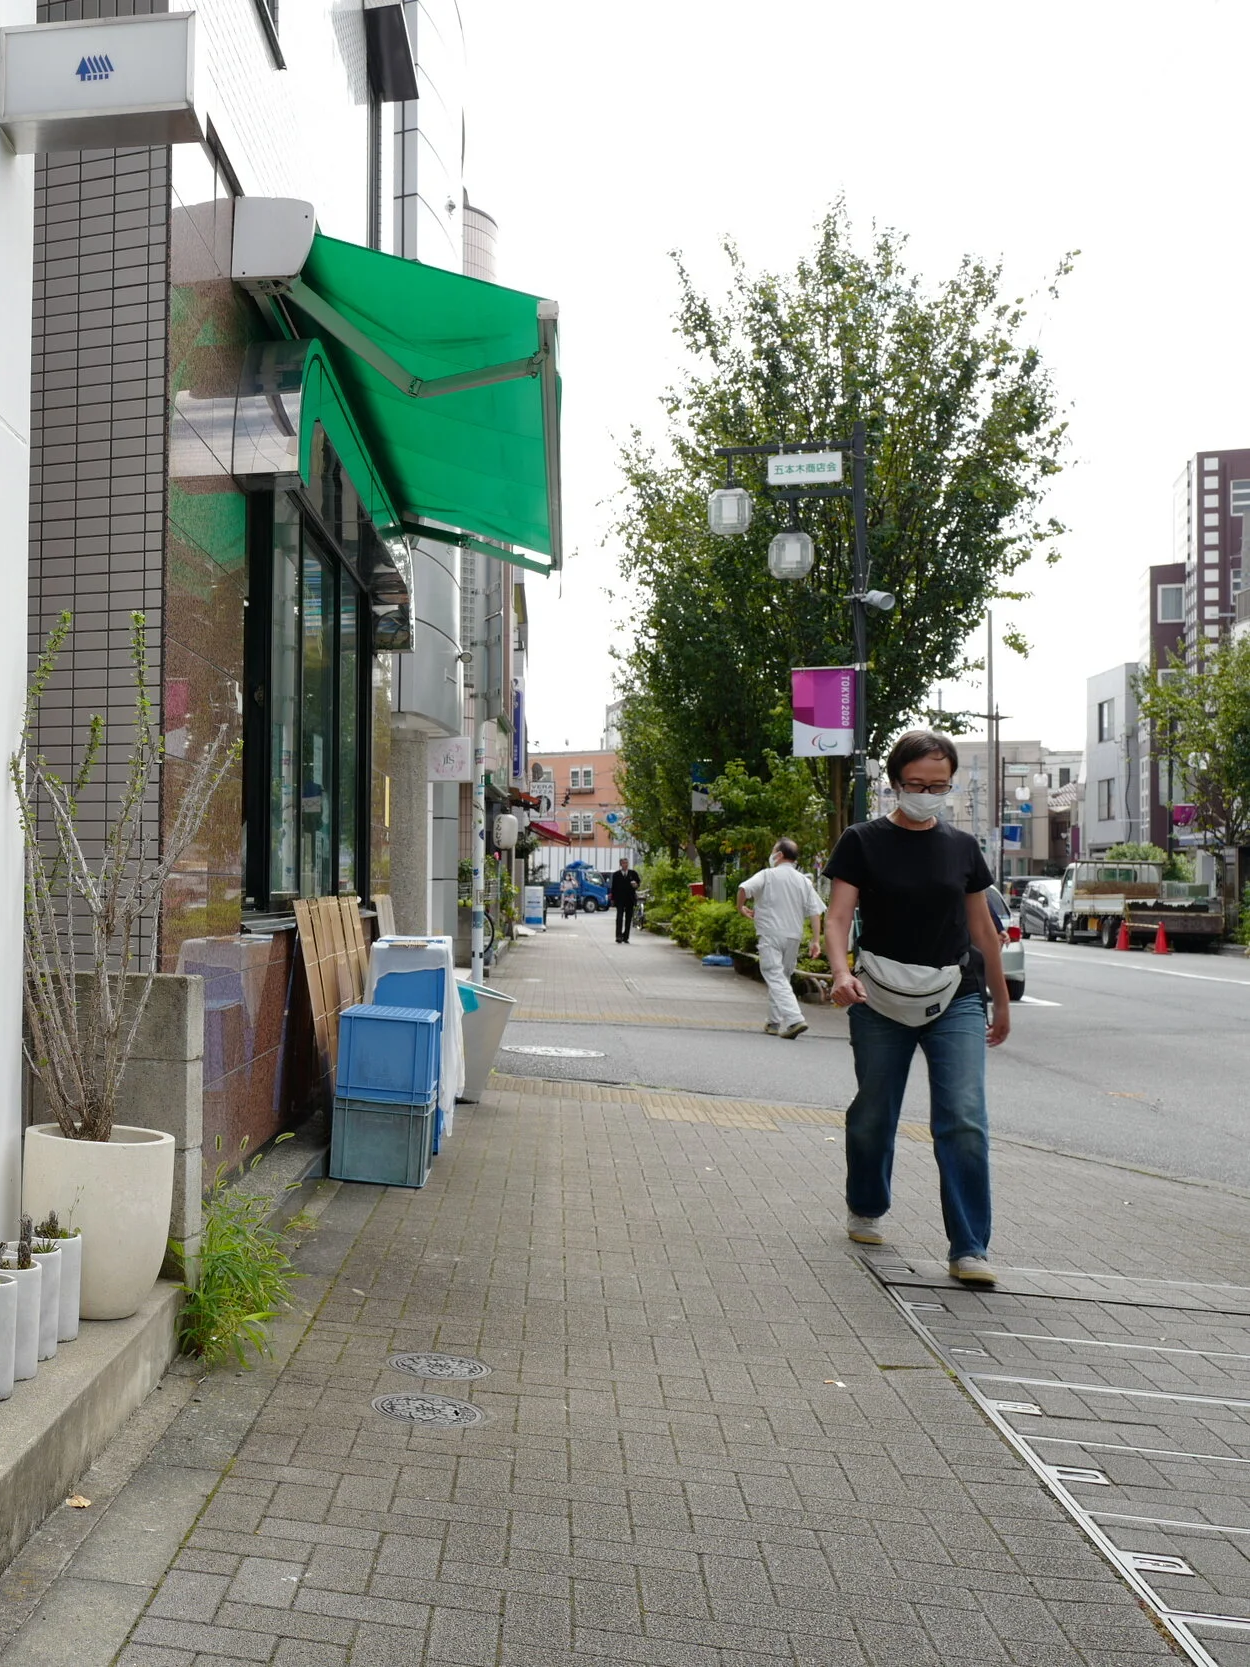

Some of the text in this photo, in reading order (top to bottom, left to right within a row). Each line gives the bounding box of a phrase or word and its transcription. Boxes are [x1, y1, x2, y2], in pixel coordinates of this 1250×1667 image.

[774, 462, 837, 475] 五本木商店会
[841, 675, 850, 727] TOKYO 2020
